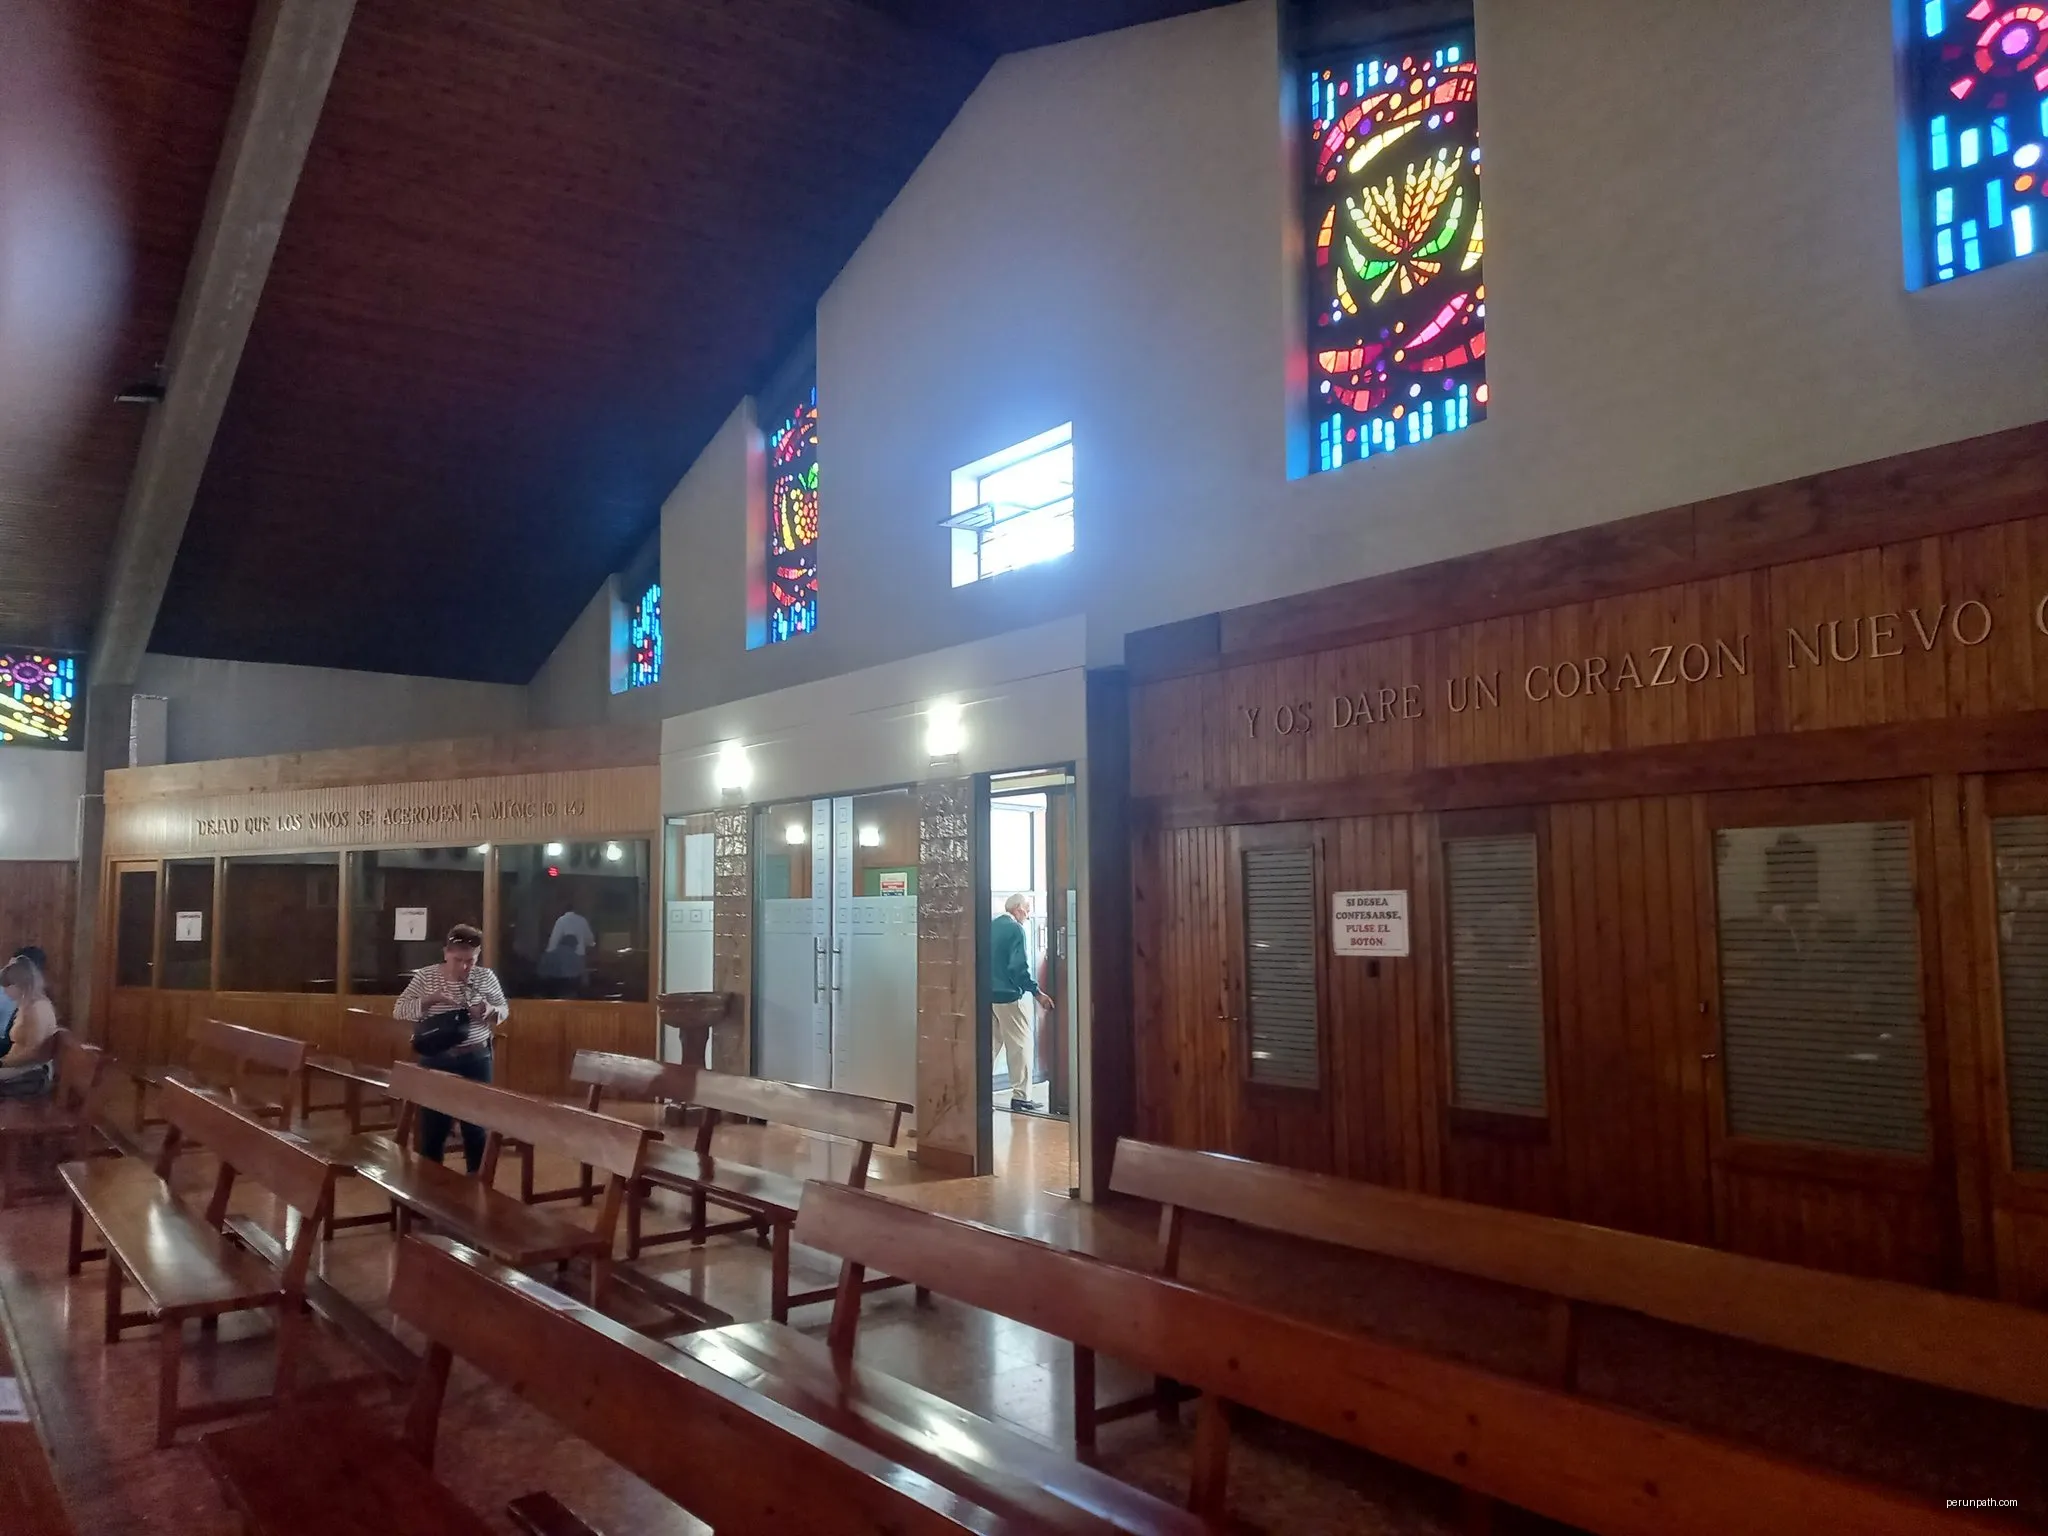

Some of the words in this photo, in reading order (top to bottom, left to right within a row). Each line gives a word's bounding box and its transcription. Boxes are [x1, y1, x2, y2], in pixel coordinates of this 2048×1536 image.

[1245, 706, 1261, 738] Y
[1275, 702, 1312, 736] OS
[1332, 684, 1425, 729] DARE
[1447, 671, 1502, 713] UN
[1524, 635, 1749, 702] CORAZON
[1786, 600, 1993, 669] NUEVO
[197, 816, 239, 836] DEJAD
[244, 815, 271, 835] QUE
[276, 813, 303, 832] LOS
[357, 808, 375, 826] SE
[383, 803, 463, 825] ACERQUEN
[470, 802, 481, 821] A
[1346, 898, 1355, 907] SI
[1357, 898, 1388, 907] DESEA
[1336, 911, 1401, 920] CONFESARSE,
[1346, 924, 1375, 933] PULSE
[1377, 924, 1391, 933] EL
